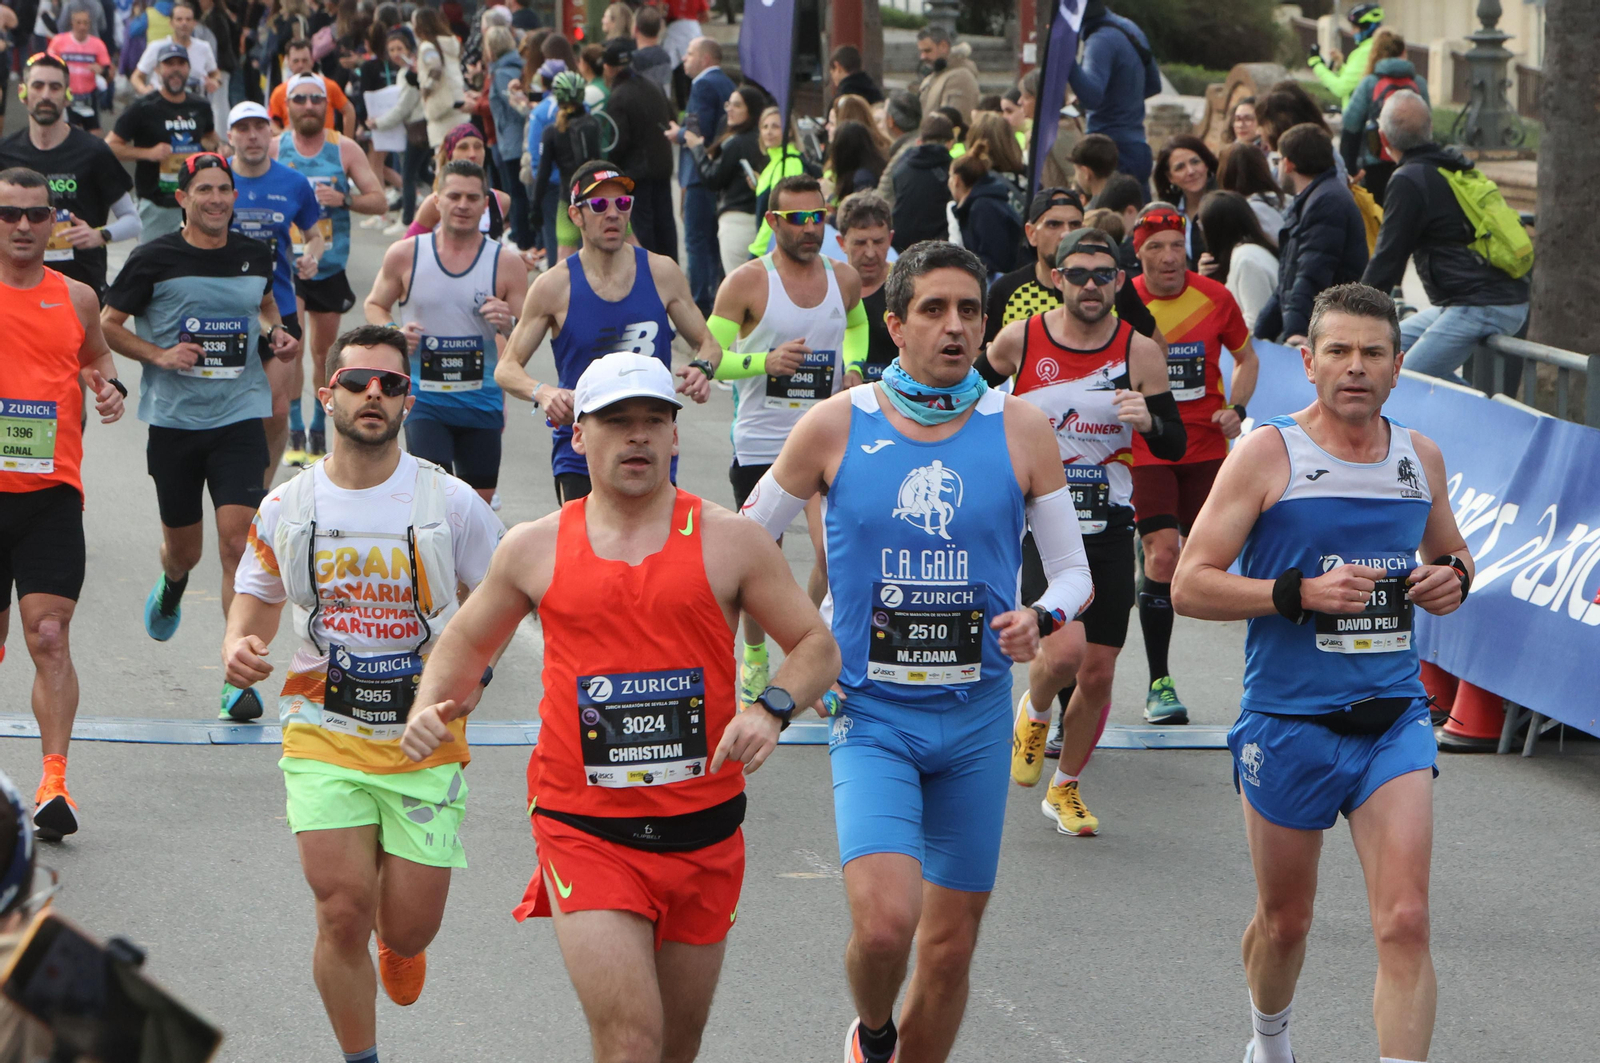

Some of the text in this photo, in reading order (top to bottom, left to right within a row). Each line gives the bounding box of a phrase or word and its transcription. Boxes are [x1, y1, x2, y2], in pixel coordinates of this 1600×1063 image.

[204, 322, 241, 331] ZURICH
[203, 341, 226, 352] 3336
[442, 340, 477, 348] ZURICH
[204, 357, 223, 366] EYAL
[804, 353, 829, 362] RICH
[787, 388, 815, 398] QUIQUE
[8, 403, 50, 415] ZURICH
[6, 426, 33, 438] 1396
[3, 446, 33, 456] CANAL
[1064, 469, 1102, 478] URICH
[315, 546, 412, 583] GRAN
[910, 591, 974, 604] ZURICH
[1337, 617, 1398, 632] DAVID PELU
[908, 624, 948, 639] 2510
[897, 650, 957, 663] M.F.DANA
[356, 657, 411, 674] ZURICH
[621, 676, 691, 695] ZURICH
[355, 688, 391, 702] 2955
[352, 707, 397, 722] NESTOR
[622, 715, 666, 735] 3024
[609, 743, 683, 762] CHRISTIAN
